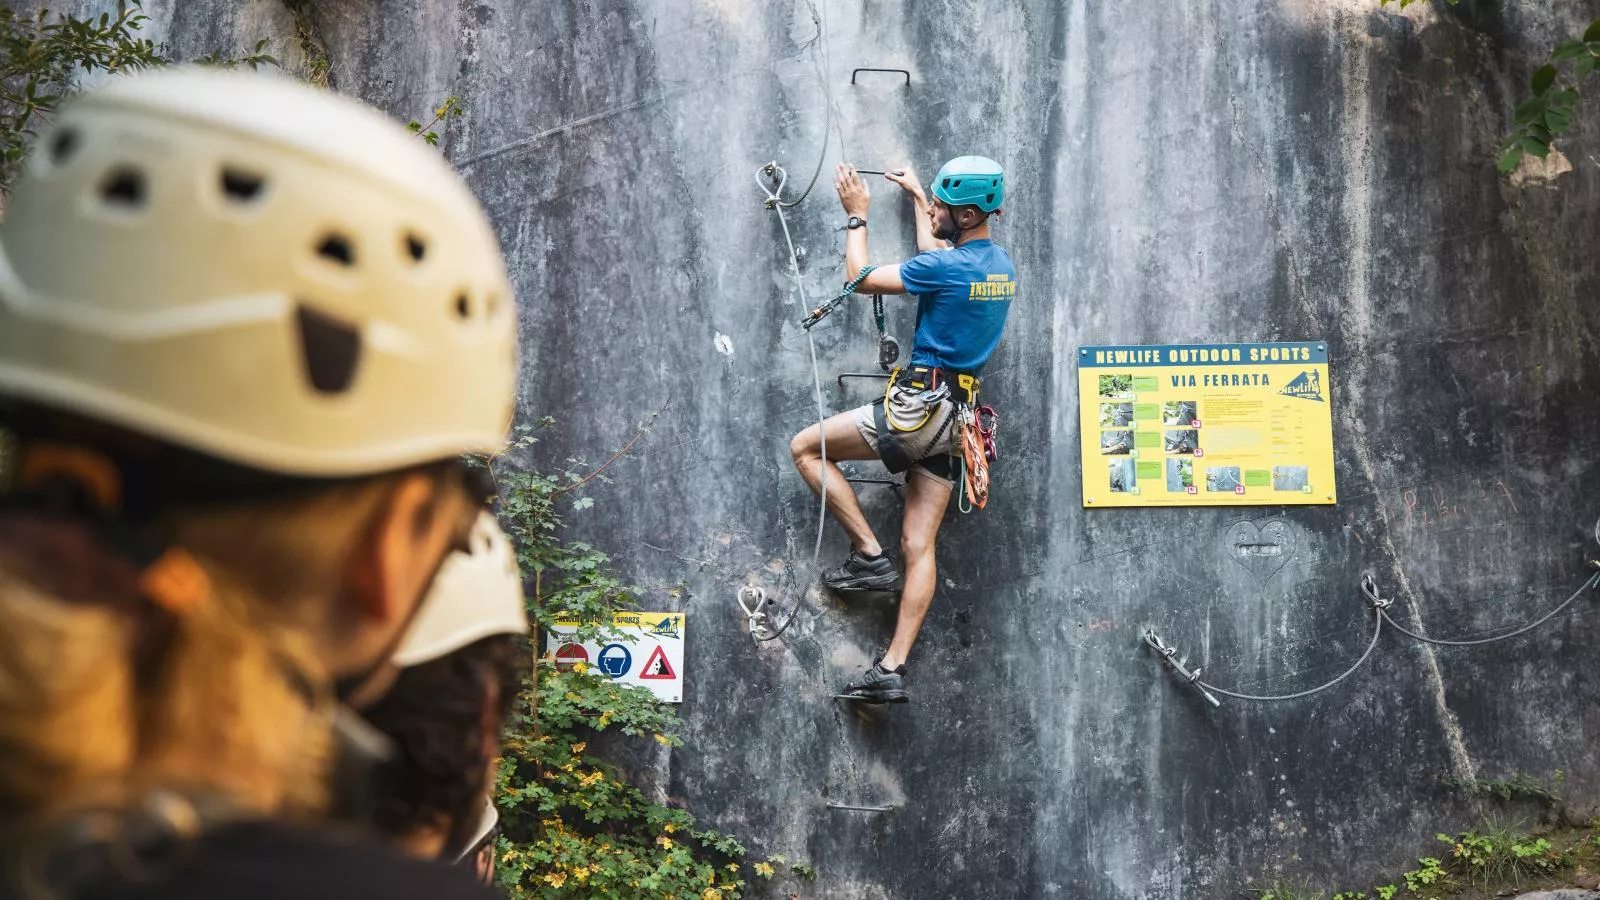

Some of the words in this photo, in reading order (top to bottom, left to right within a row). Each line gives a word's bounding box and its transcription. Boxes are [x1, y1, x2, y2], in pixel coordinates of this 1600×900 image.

[1096, 350, 1160, 364] NEWLIFE
[1169, 348, 1241, 363] OUTDOOR
[1250, 346, 1310, 361] SPORTS
[1171, 374, 1197, 387] VIA
[1203, 373, 1270, 387] FERRATA
[616, 616, 640, 624] SPORTS
